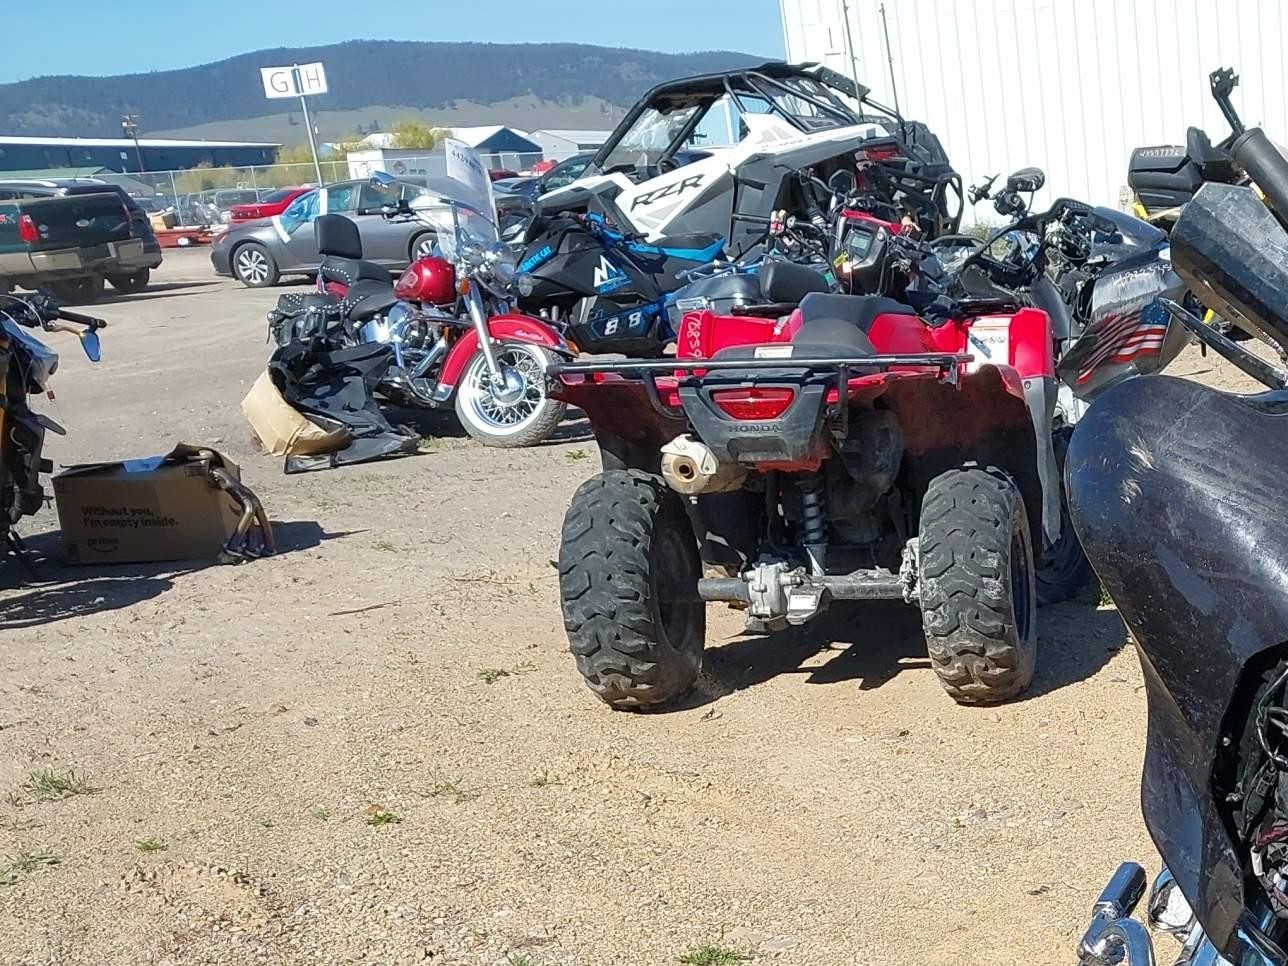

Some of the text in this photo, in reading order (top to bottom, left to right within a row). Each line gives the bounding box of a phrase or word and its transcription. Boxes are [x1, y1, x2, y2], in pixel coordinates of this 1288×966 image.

[270, 68, 321, 93] G H
[630, 174, 705, 212] RZR
[728, 424, 783, 433] HONDA
[80, 505, 154, 518] Without you,
[82, 516, 179, 529] I'm empty inside.
